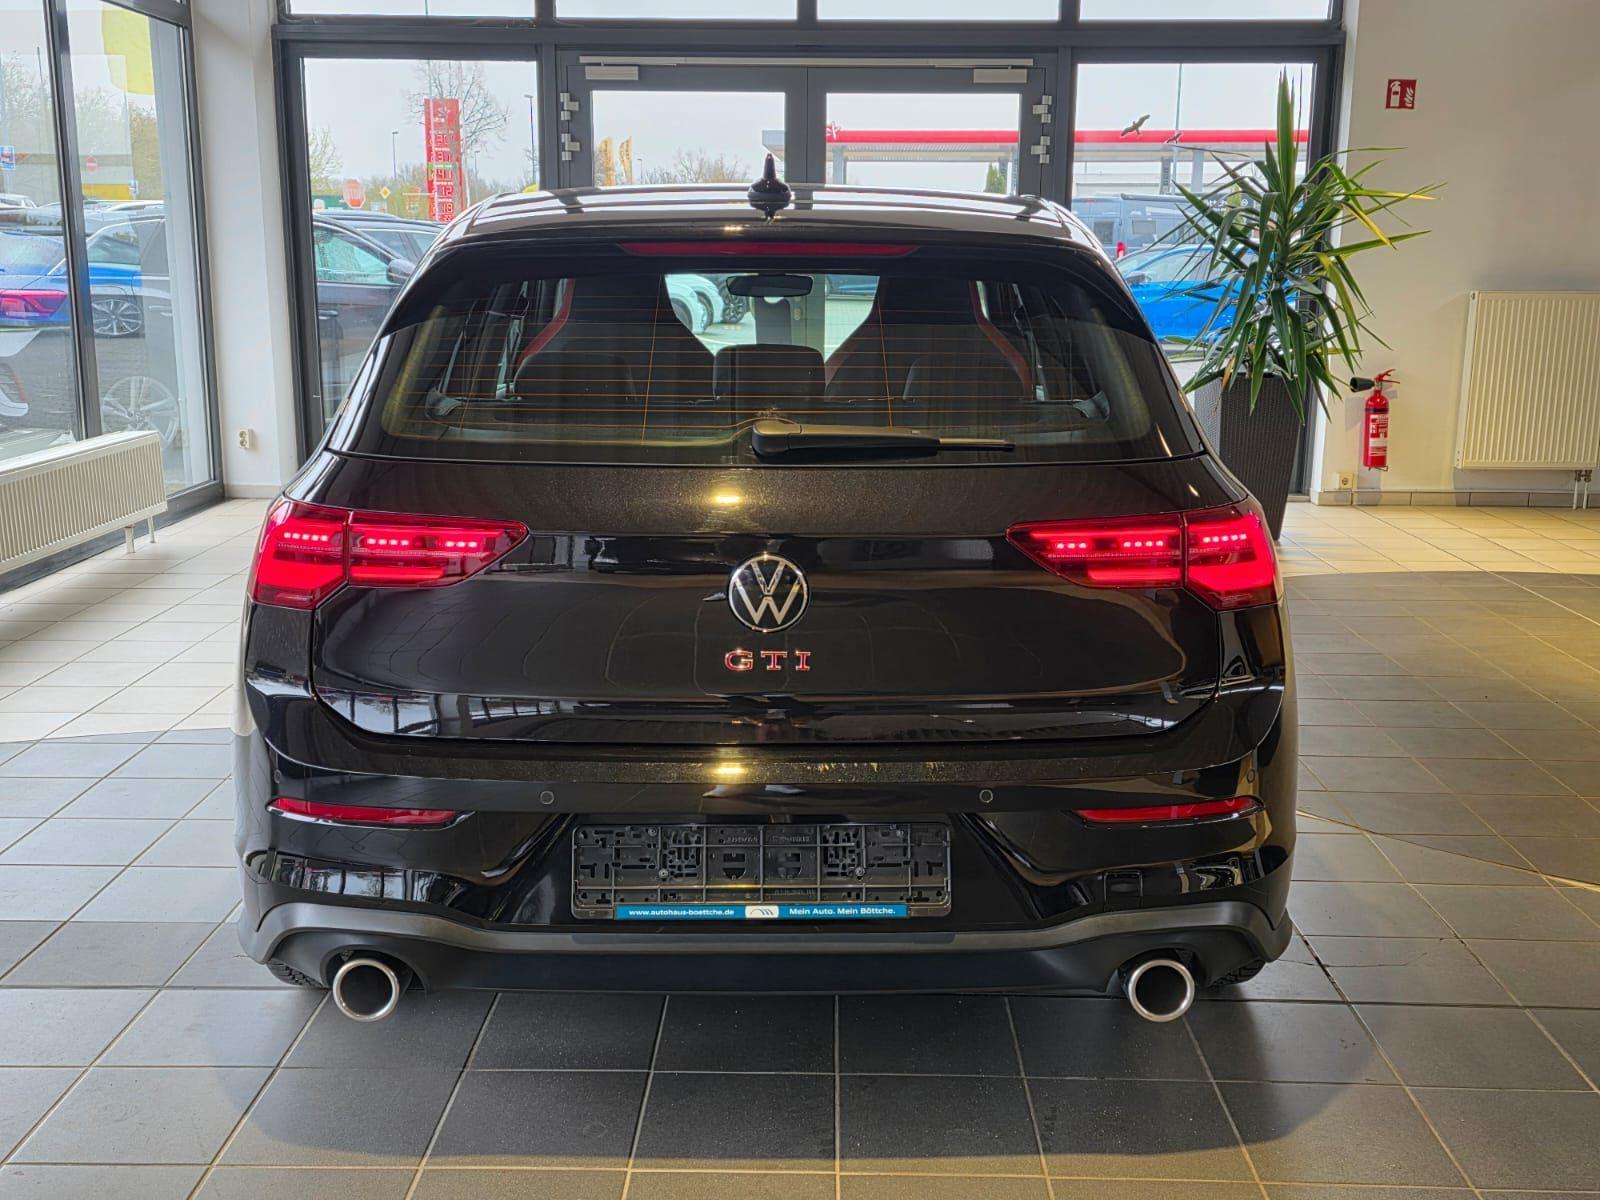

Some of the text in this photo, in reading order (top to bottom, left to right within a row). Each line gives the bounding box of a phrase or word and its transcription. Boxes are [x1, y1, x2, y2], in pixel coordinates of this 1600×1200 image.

[725, 649, 811, 671] GTI
[628, 906, 896, 917] www.autohaus-boettche.de Mein Auto. Mein Böttche.
